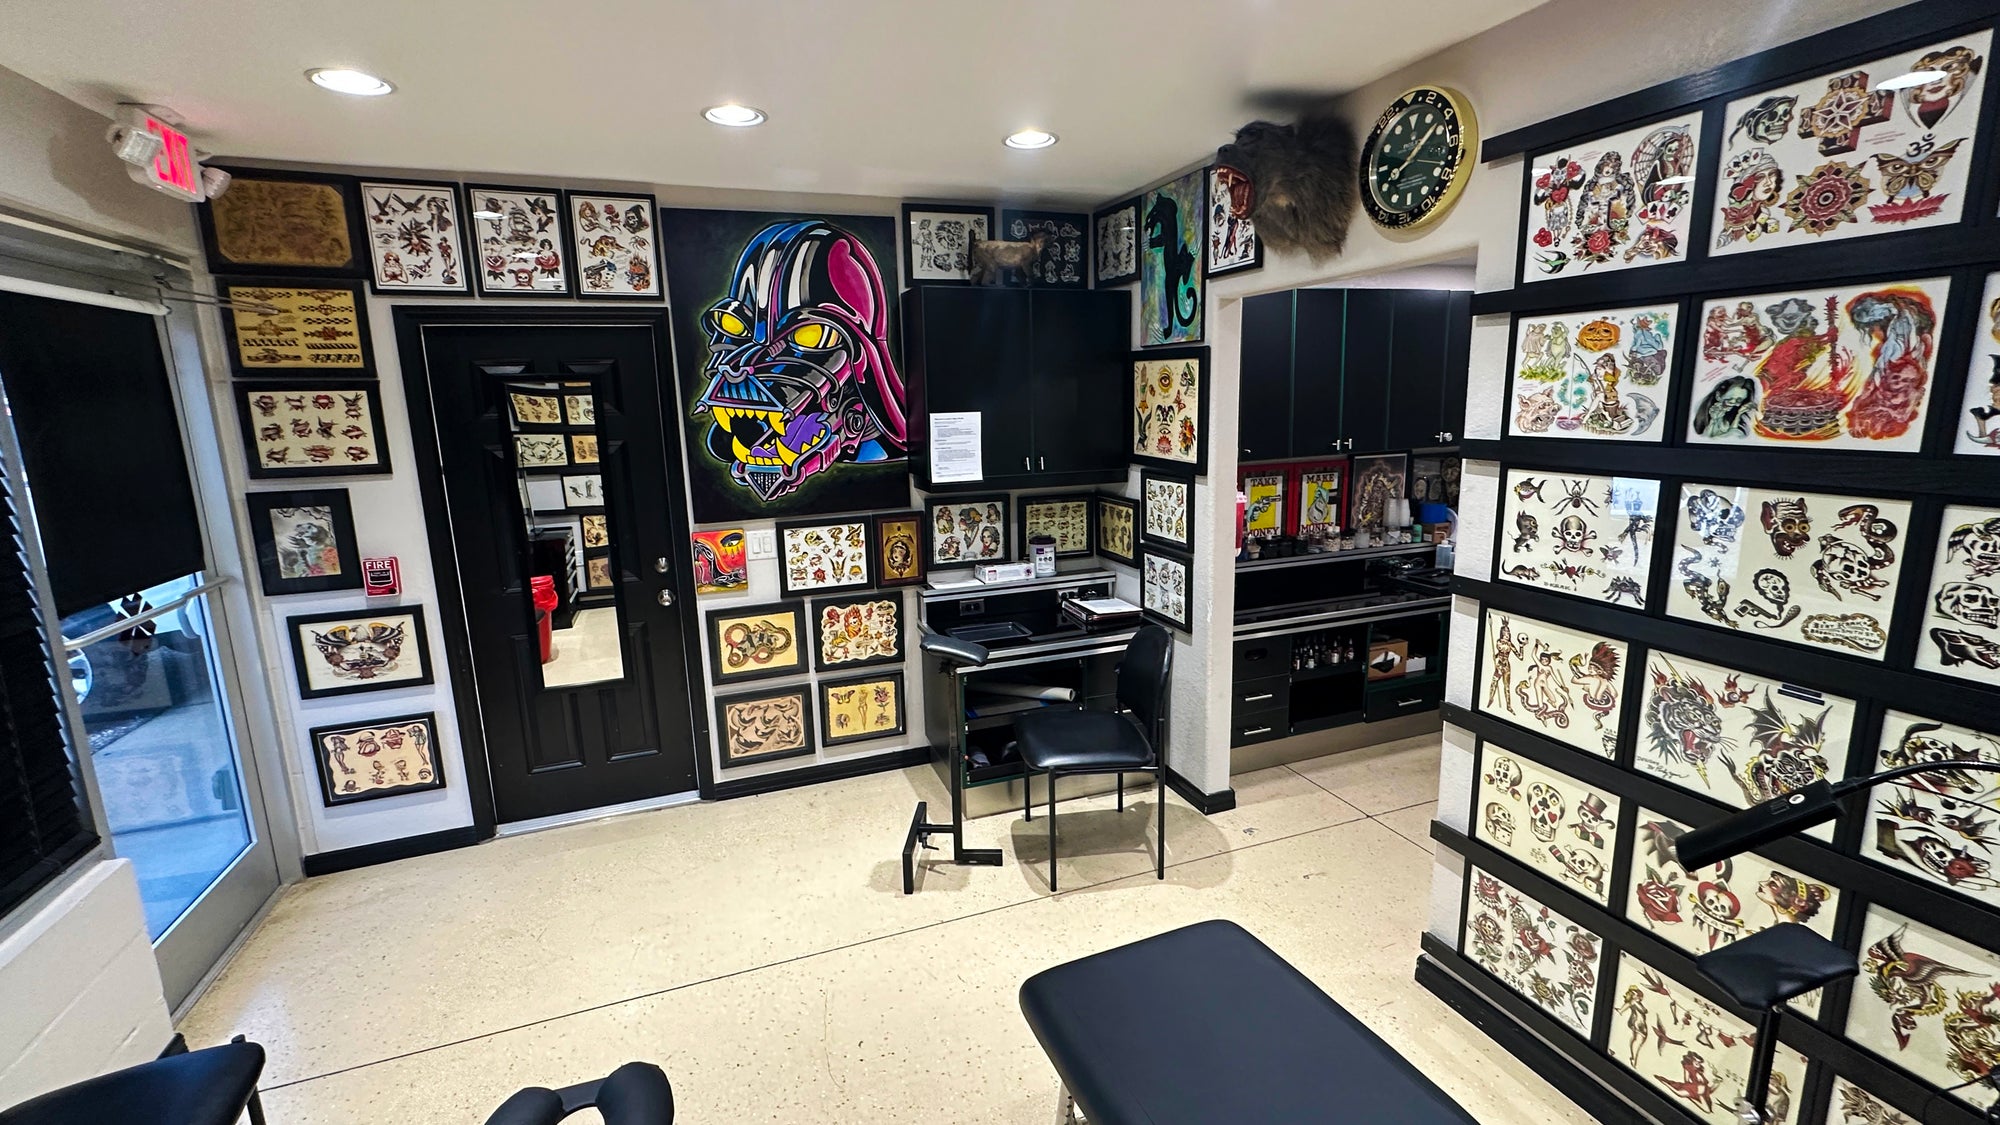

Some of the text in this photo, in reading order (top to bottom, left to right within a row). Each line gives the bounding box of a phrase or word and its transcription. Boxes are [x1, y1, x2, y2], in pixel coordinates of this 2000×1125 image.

[1425, 91, 1437, 104] 2
[1443, 107, 1455, 120] 4
[1441, 167, 1452, 180] 8
[1421, 195, 1436, 211] 10
[1251, 477, 1278, 487] TAKE
[1306, 474, 1335, 484] MAKE
[365, 560, 392, 570] FIRE
[1696, 911, 1736, 933] DEATH
